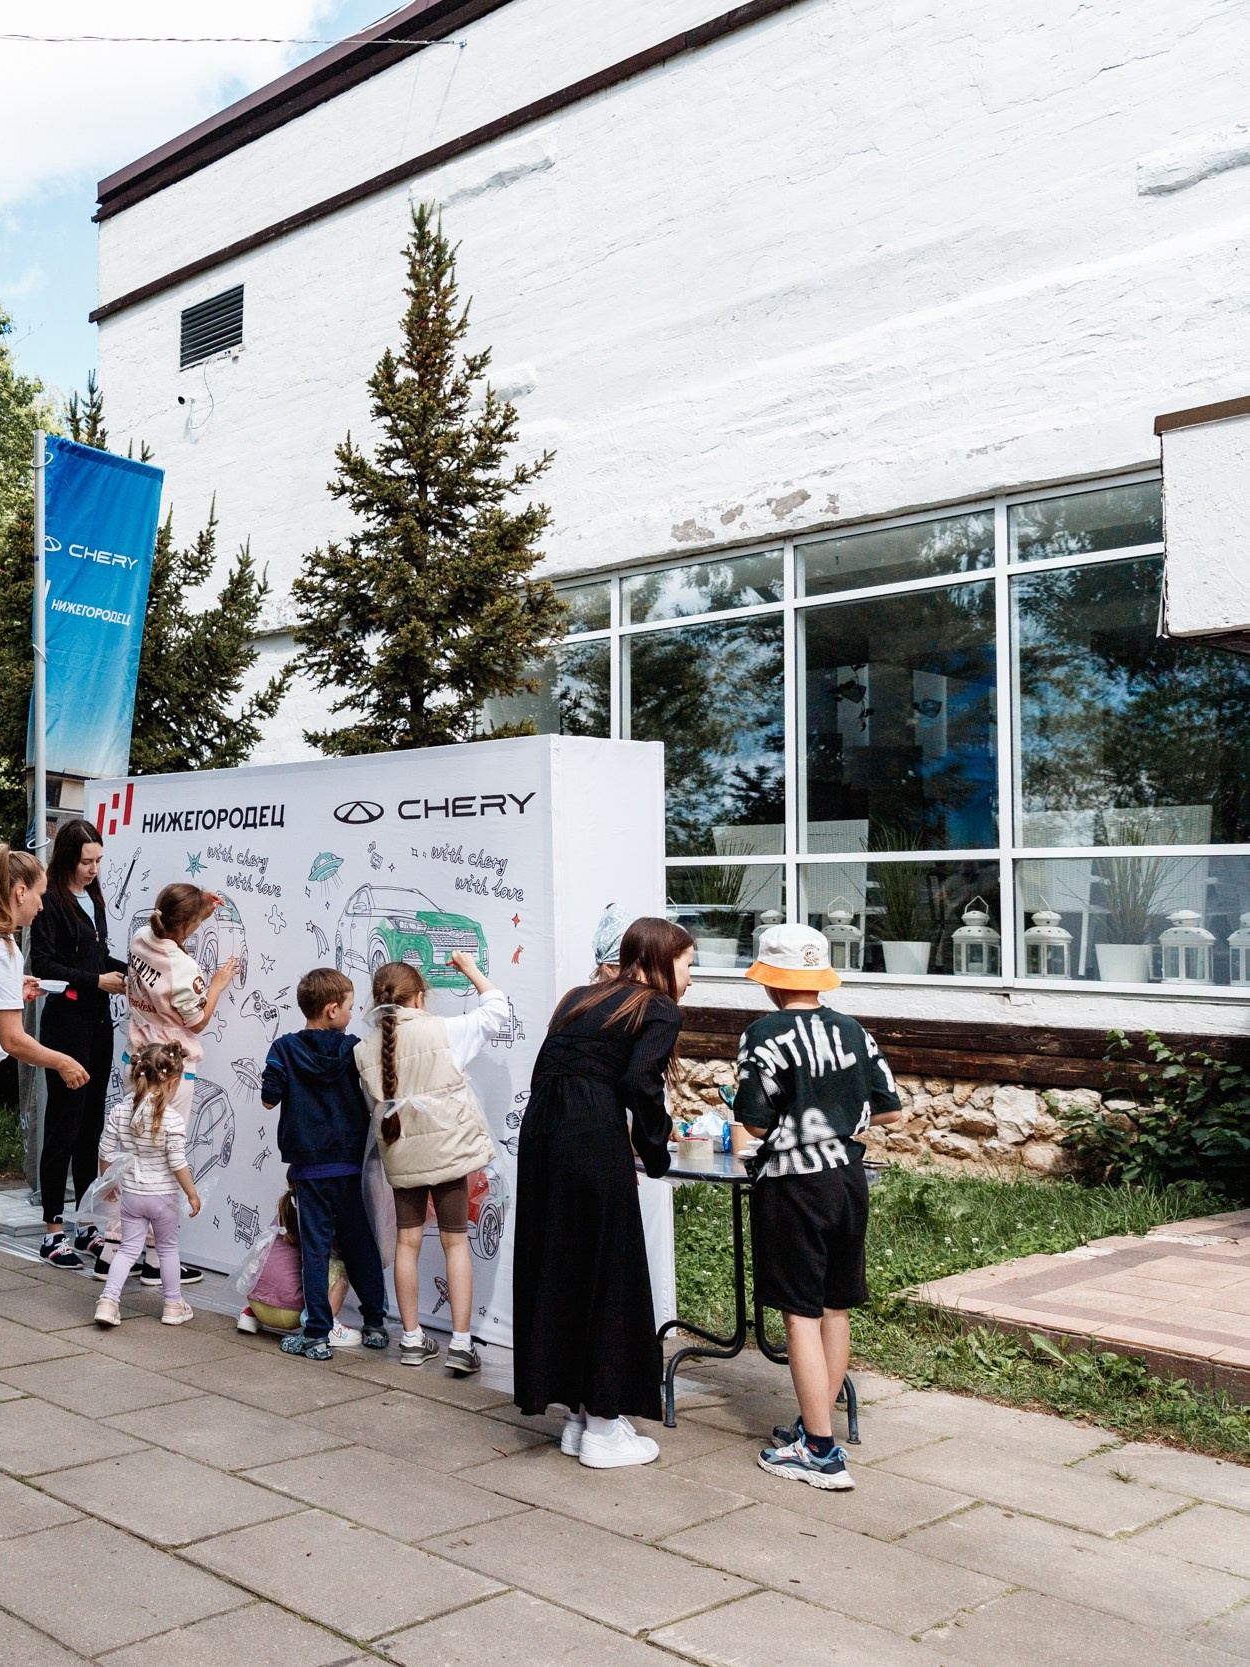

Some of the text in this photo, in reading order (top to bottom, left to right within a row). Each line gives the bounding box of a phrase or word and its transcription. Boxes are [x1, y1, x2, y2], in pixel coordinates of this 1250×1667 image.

[68, 543, 139, 571] CHERY
[50, 598, 131, 626] НИЖЕГОРОДЕЦ
[141, 804, 285, 834] НИЖЕГОРОДЕЦ
[397, 791, 537, 820] CHERY
[206, 843, 269, 875] with chery
[430, 843, 509, 877] with chery
[225, 871, 282, 898] with love
[454, 874, 525, 902] with love
